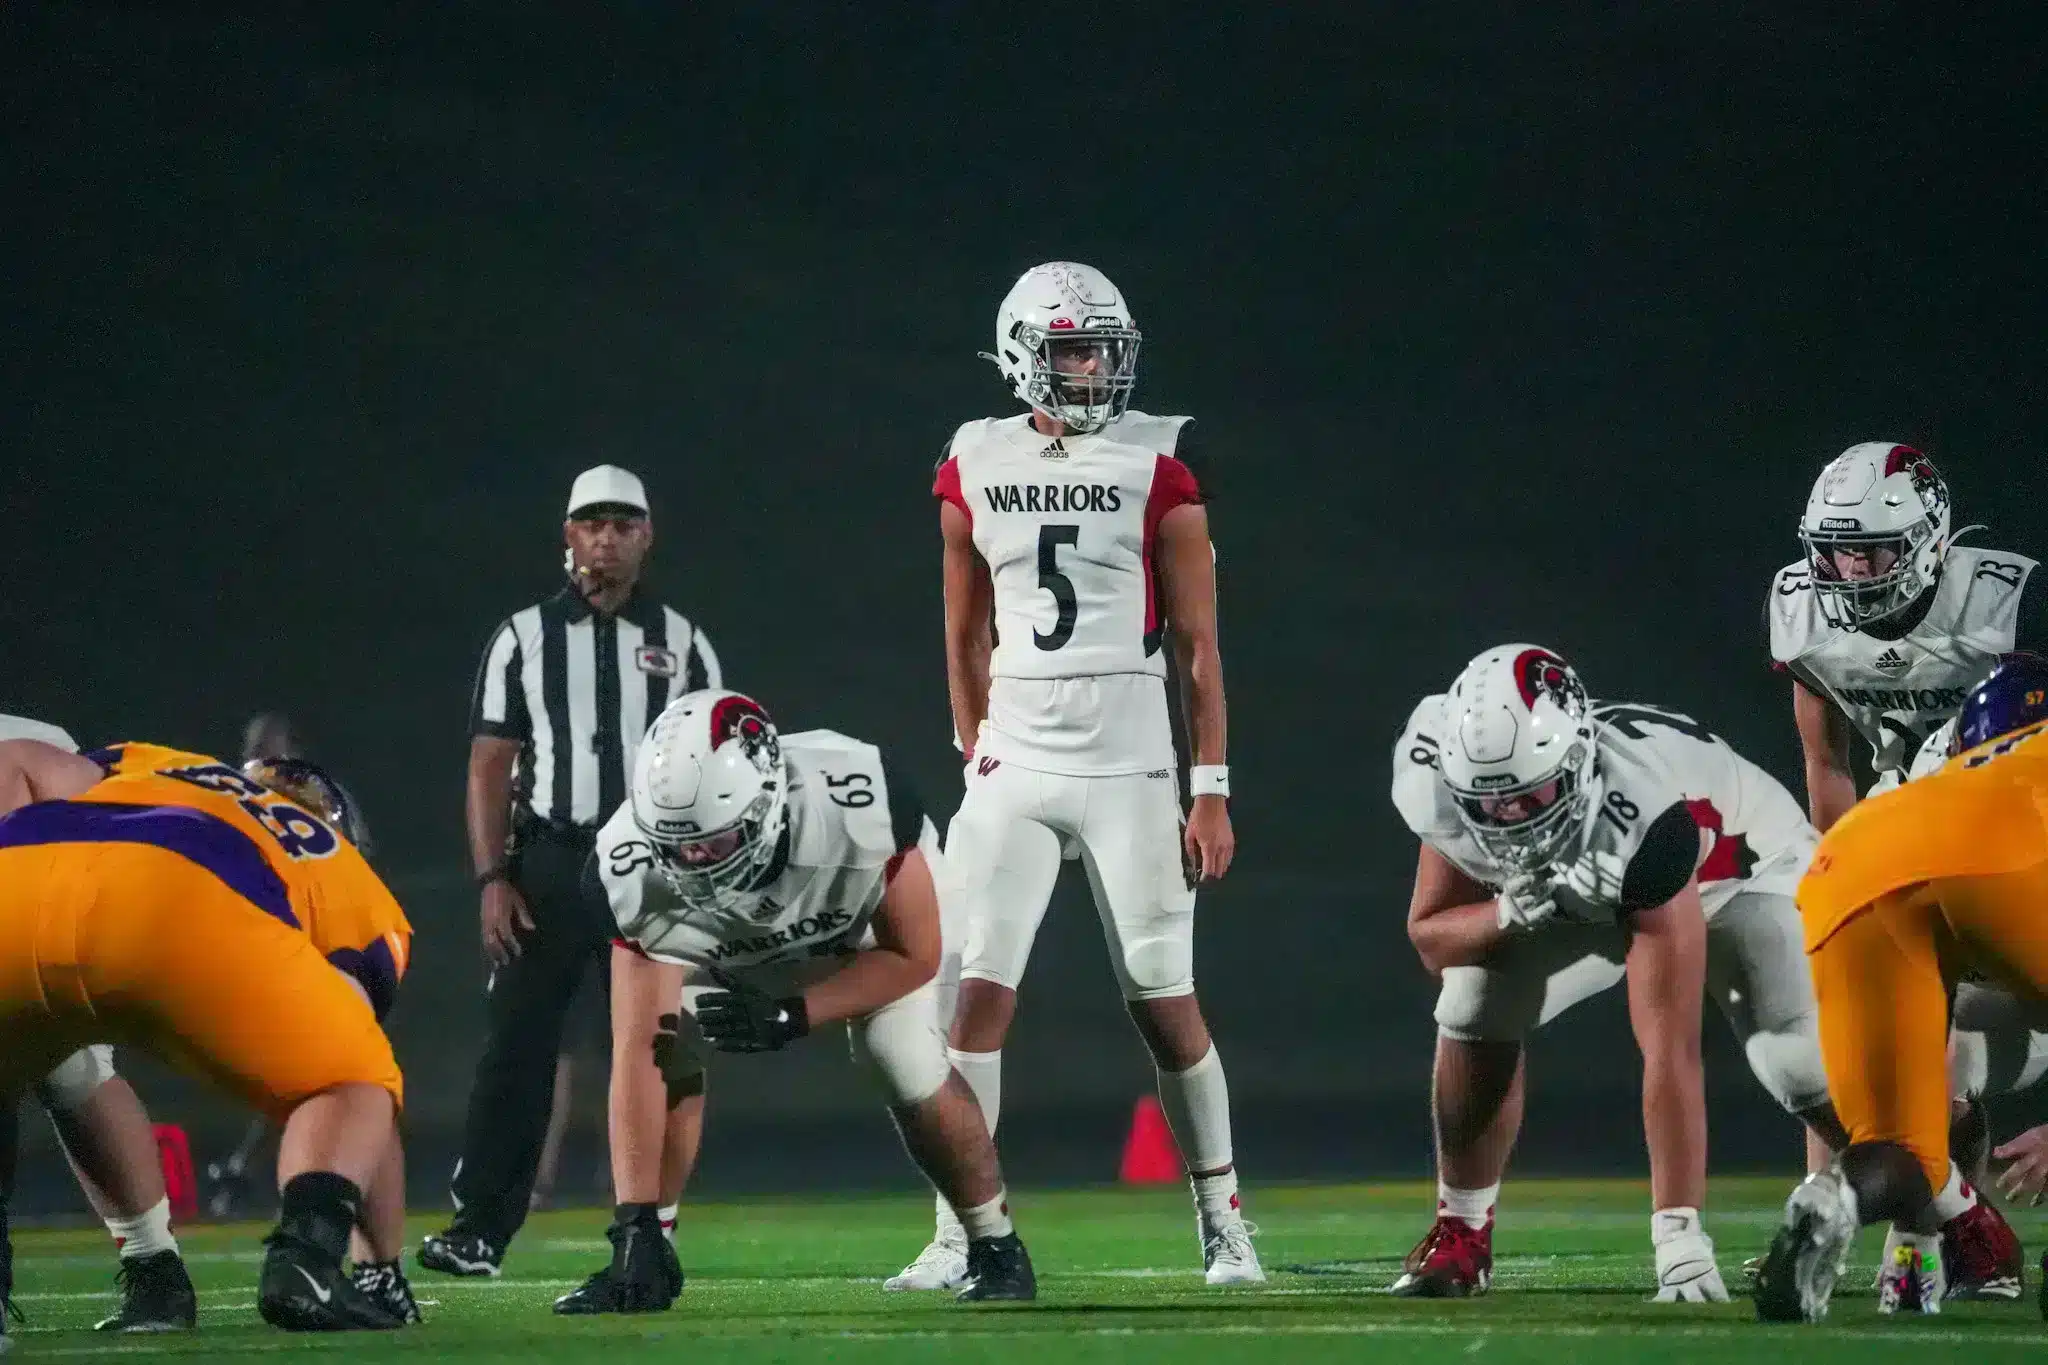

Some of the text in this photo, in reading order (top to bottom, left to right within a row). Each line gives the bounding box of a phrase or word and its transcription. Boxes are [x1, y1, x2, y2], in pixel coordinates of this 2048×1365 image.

[1040, 449, 1069, 459] adidas
[984, 484, 1122, 513] WARRIORS
[1822, 519, 1856, 529] Riddell
[1032, 525, 1080, 652] 5
[1834, 686, 1968, 711] WARRIORS
[826, 773, 874, 808] 65
[610, 841, 655, 877] 65
[705, 908, 852, 960] WARRIORS
